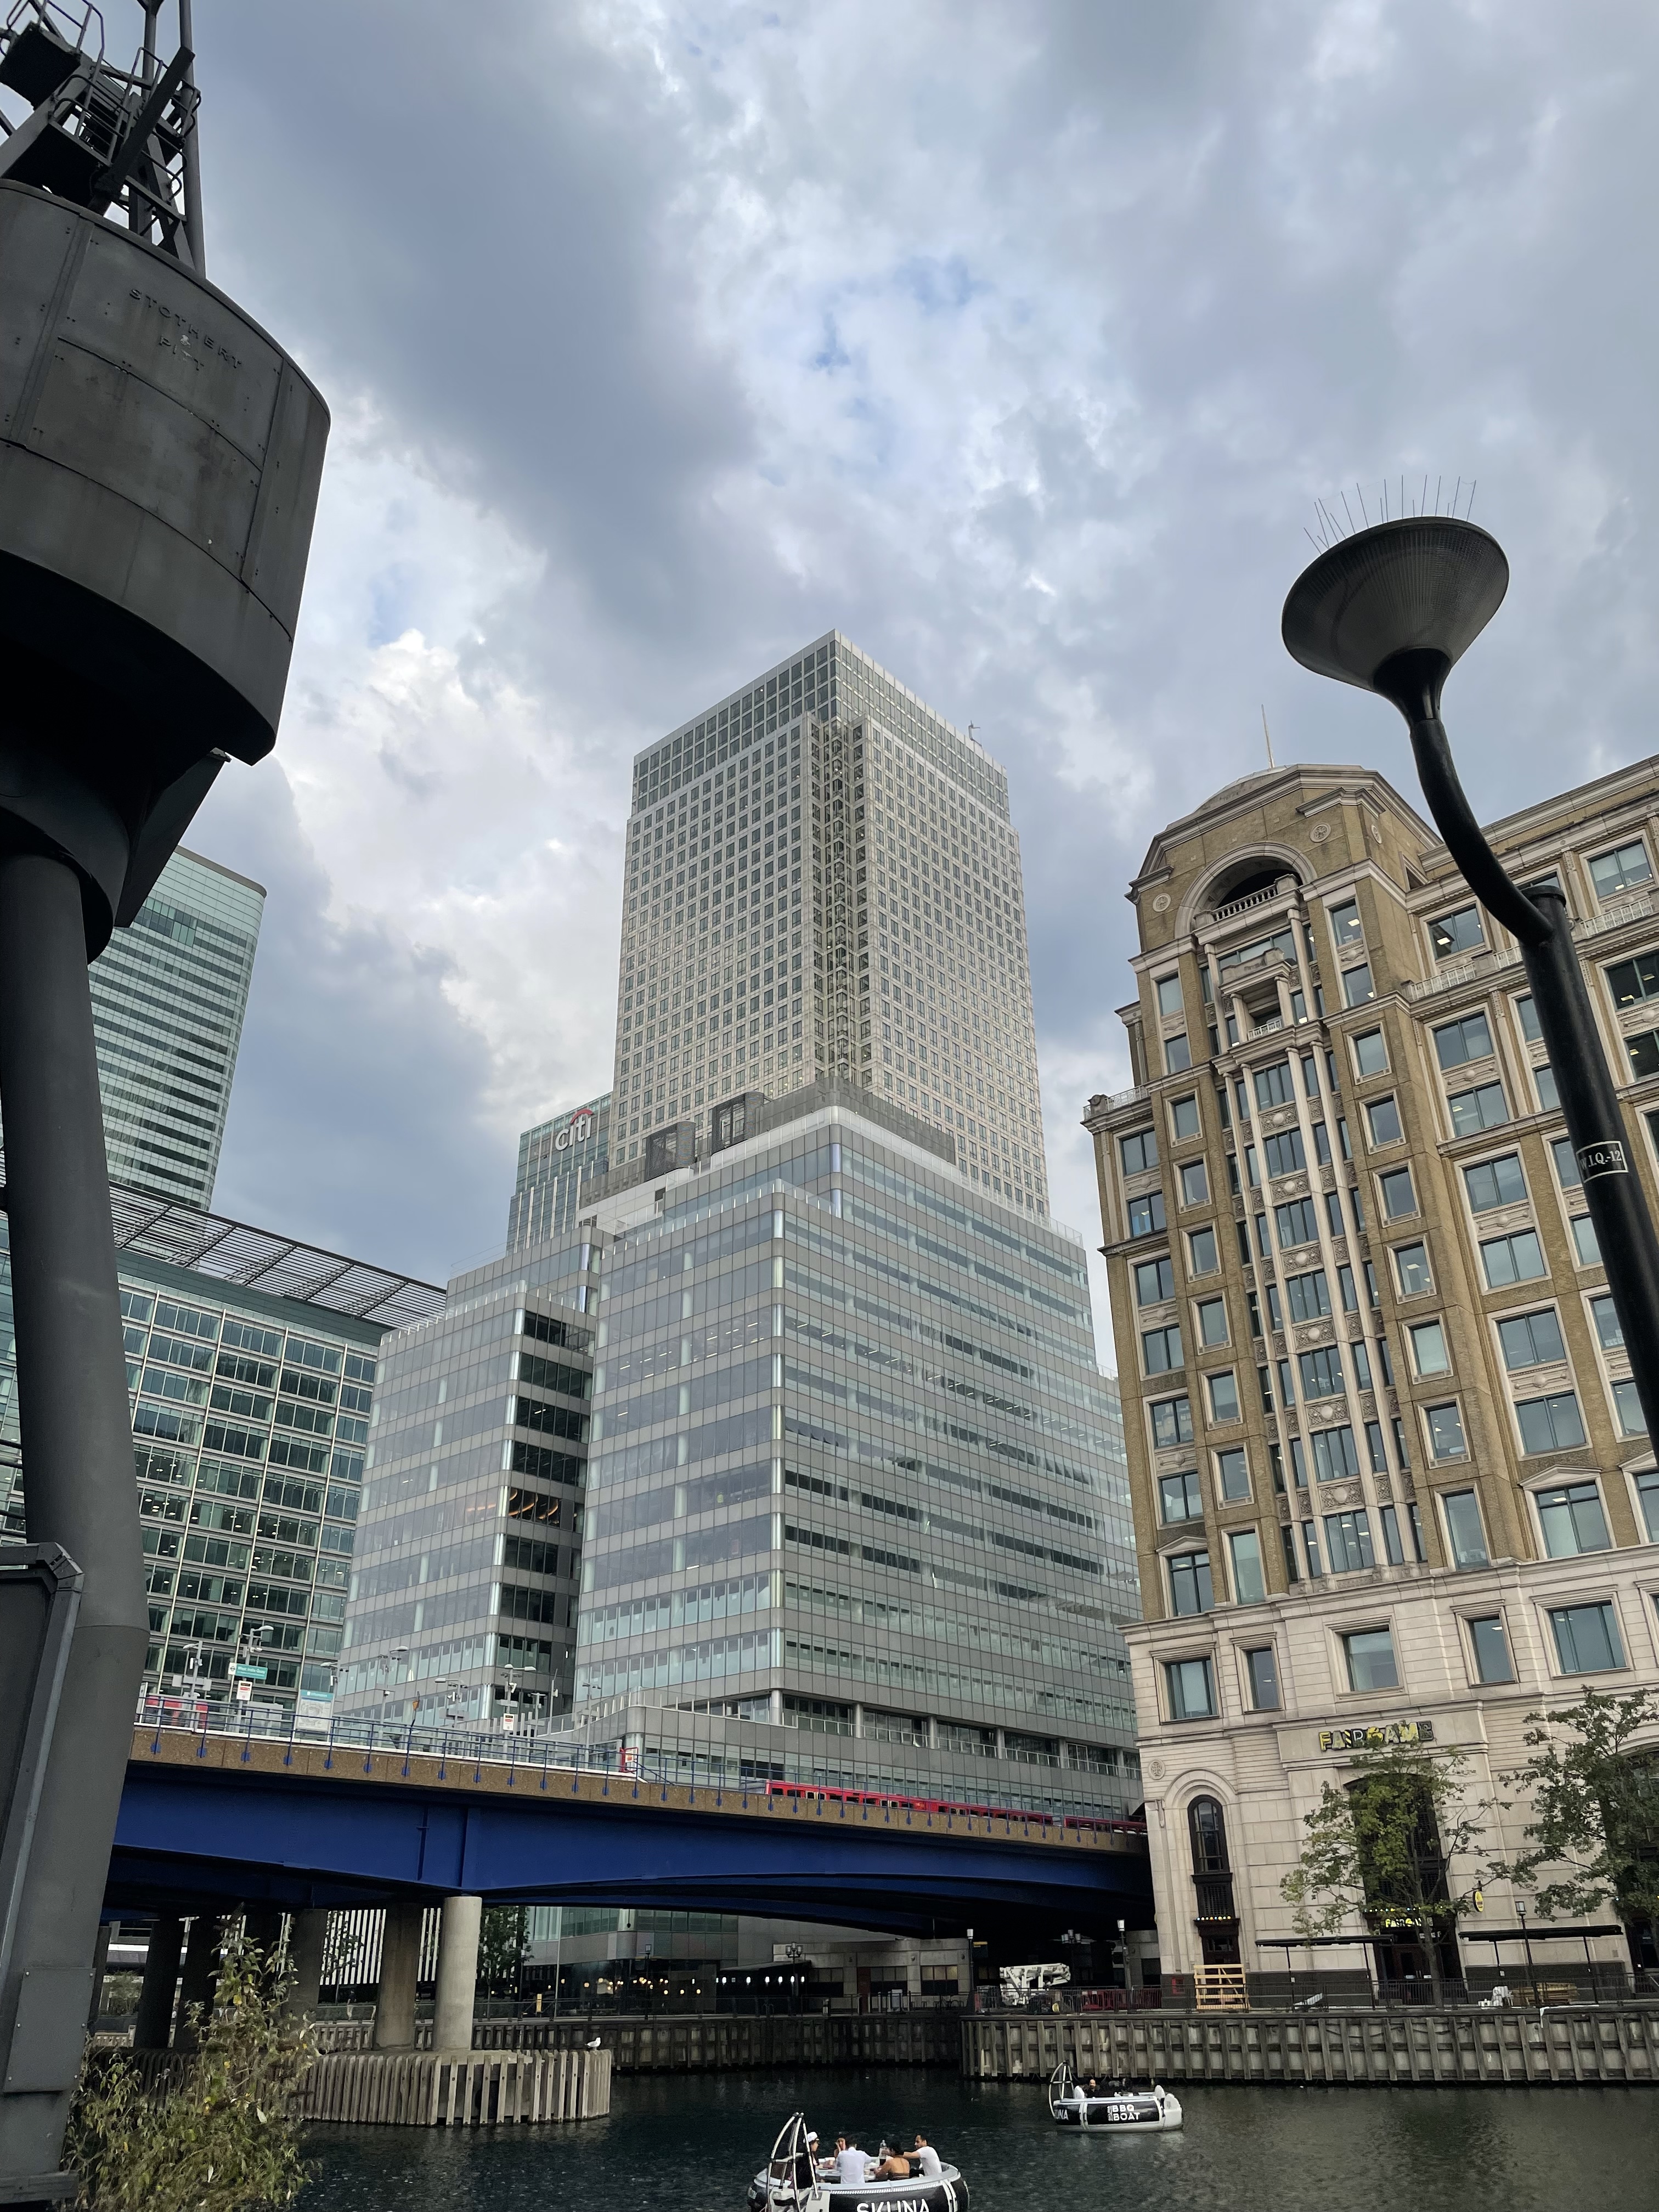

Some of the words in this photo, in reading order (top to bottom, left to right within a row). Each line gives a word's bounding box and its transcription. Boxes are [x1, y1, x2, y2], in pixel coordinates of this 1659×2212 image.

[129, 289, 242, 368] STOTHERT
[555, 1114, 591, 1150] citi
[1113, 2104, 1135, 2113] BBQ
[1113, 2113, 1140, 2121] BOAT
